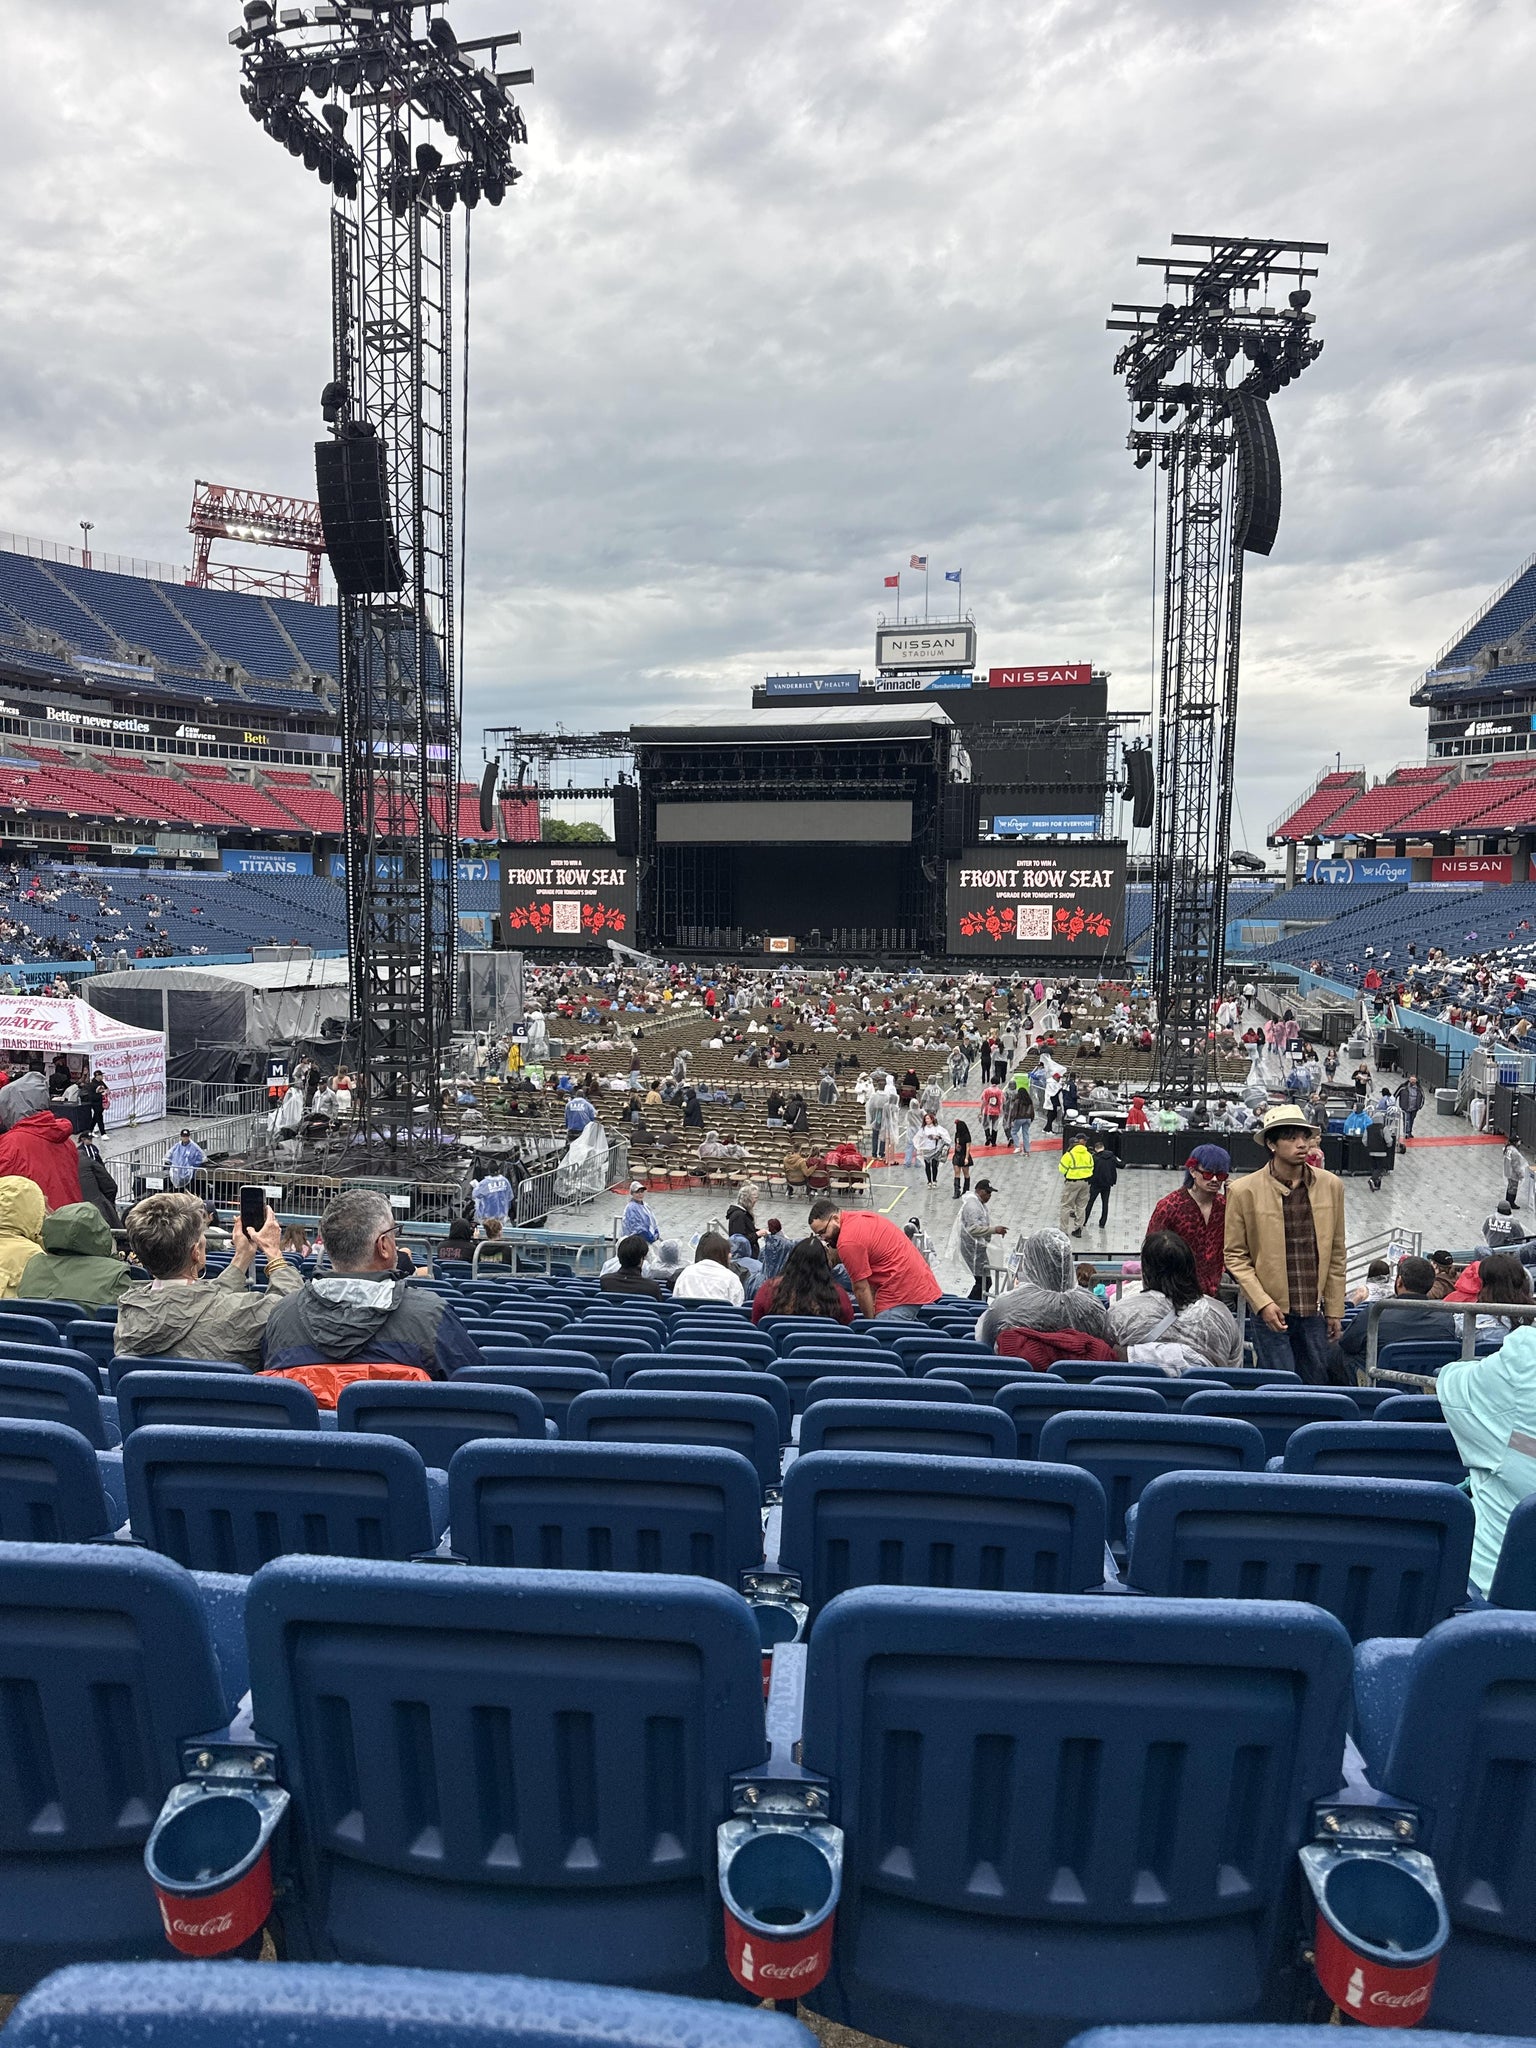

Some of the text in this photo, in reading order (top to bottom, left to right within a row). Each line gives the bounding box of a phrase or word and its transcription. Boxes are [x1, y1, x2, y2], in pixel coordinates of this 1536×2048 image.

[892, 639, 955, 650] NISSAN
[902, 650, 944, 658] STADIUM
[1002, 670, 1077, 683] NISSAN
[774, 682, 812, 690] VANDERBILT
[877, 678, 921, 691] Pinnacle
[46, 706, 150, 733] Better never settles
[185, 732, 216, 740] SERVICES
[1476, 726, 1512, 736] SERVICES
[1007, 818, 1029, 831] Kroger
[239, 860, 297, 873] TITANS
[1442, 861, 1502, 871] NISSAN
[508, 868, 627, 886] FRONT ROW SEAT
[1375, 862, 1407, 882] Kroger
[959, 869, 1115, 888] FRONT ROW SEAT
[14, 1007, 35, 1016] THE
[516, 1027, 525, 1036] G
[2, 1038, 62, 1051] MARS MERCH
[93, 1042, 116, 1052] OFFICIAL
[1291, 1042, 1299, 1051] F
[272, 1064, 284, 1076] M
